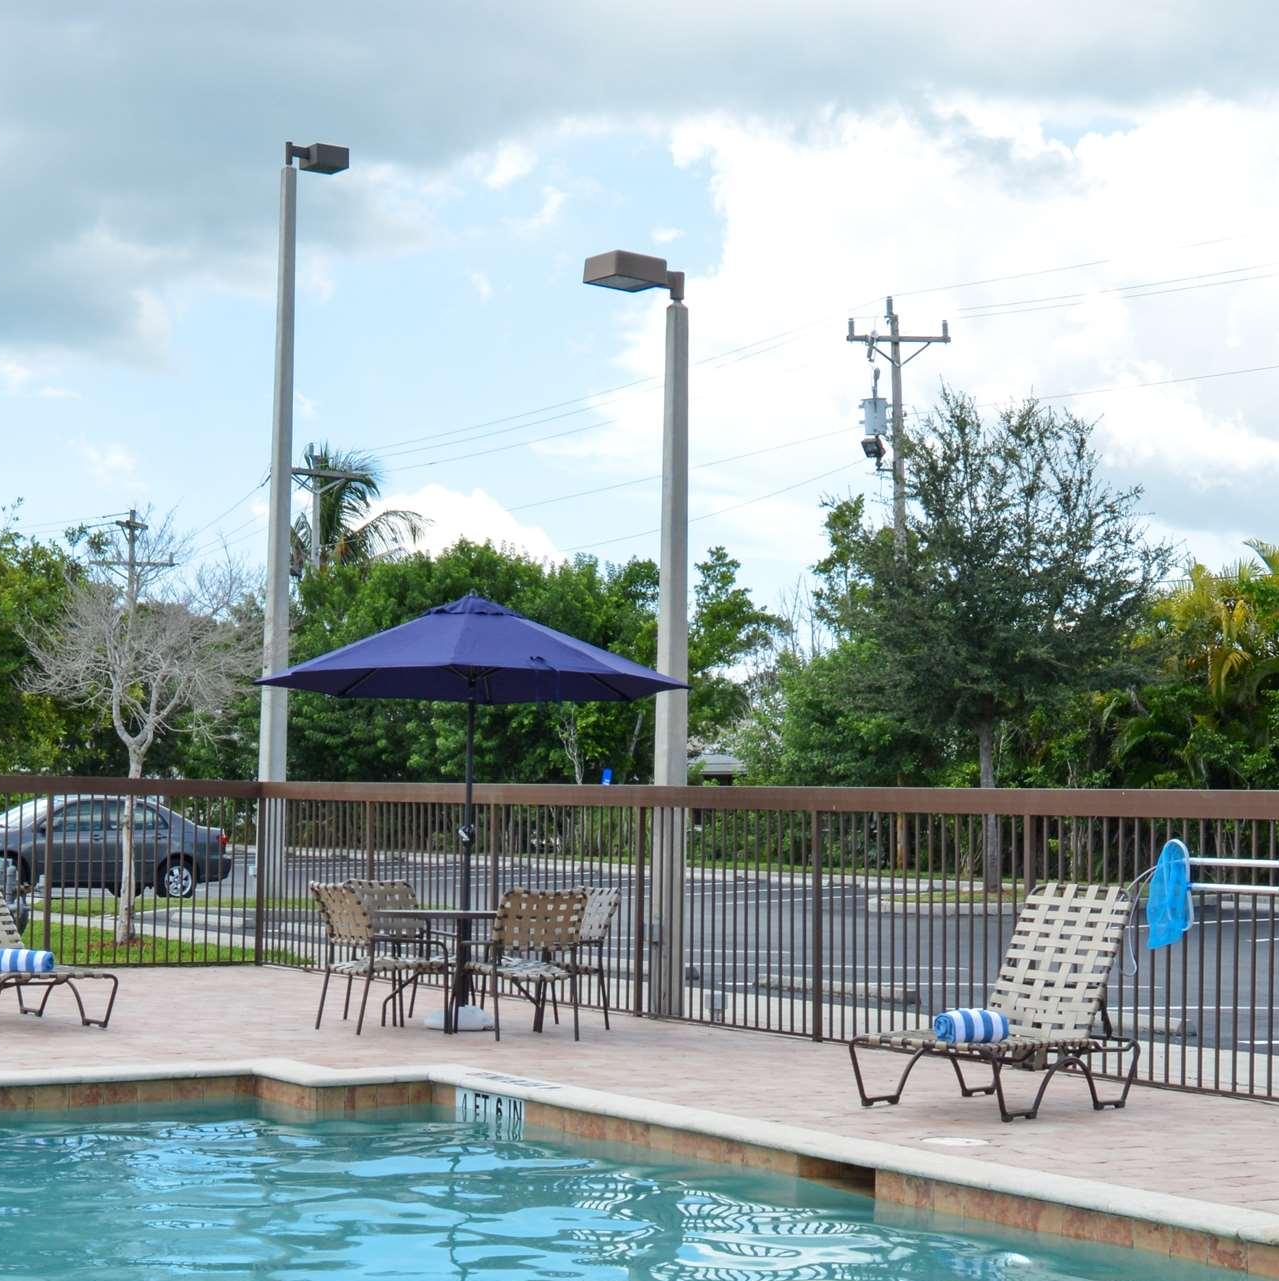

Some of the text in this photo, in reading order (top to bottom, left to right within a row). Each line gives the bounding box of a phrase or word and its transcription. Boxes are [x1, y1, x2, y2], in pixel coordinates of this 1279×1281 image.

[474, 1092, 490, 1116] FT
[495, 1097, 503, 1118] 6
[508, 1099, 523, 1121] IN
